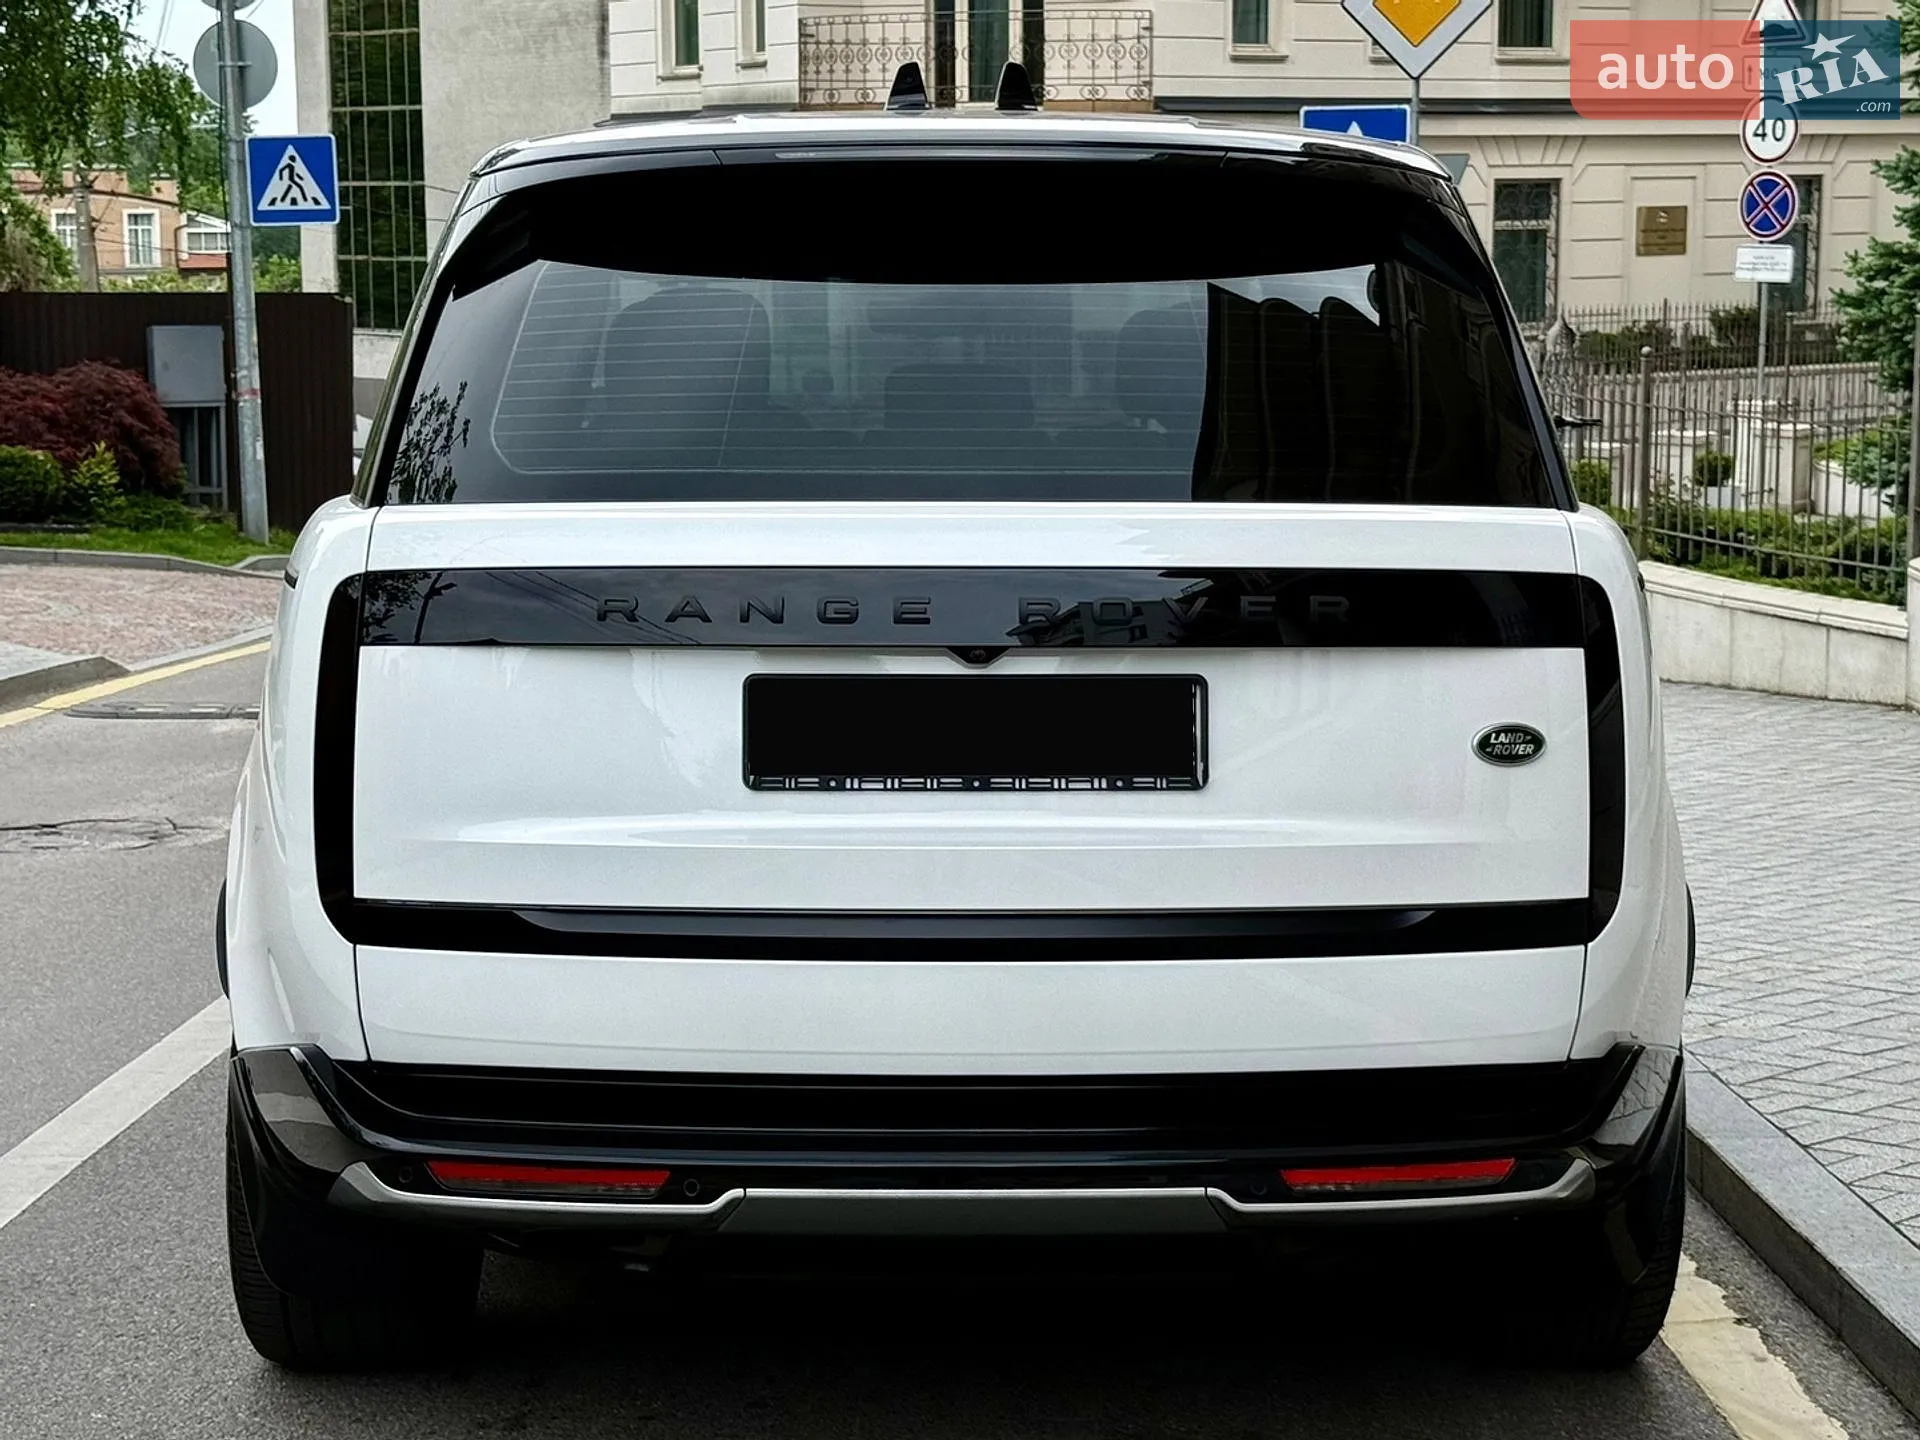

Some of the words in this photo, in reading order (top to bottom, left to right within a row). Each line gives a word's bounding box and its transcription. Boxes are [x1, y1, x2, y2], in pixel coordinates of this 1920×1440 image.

[1753, 117, 1786, 142] 40
[597, 595, 931, 625] RANGE
[1019, 595, 1350, 625] ROVER
